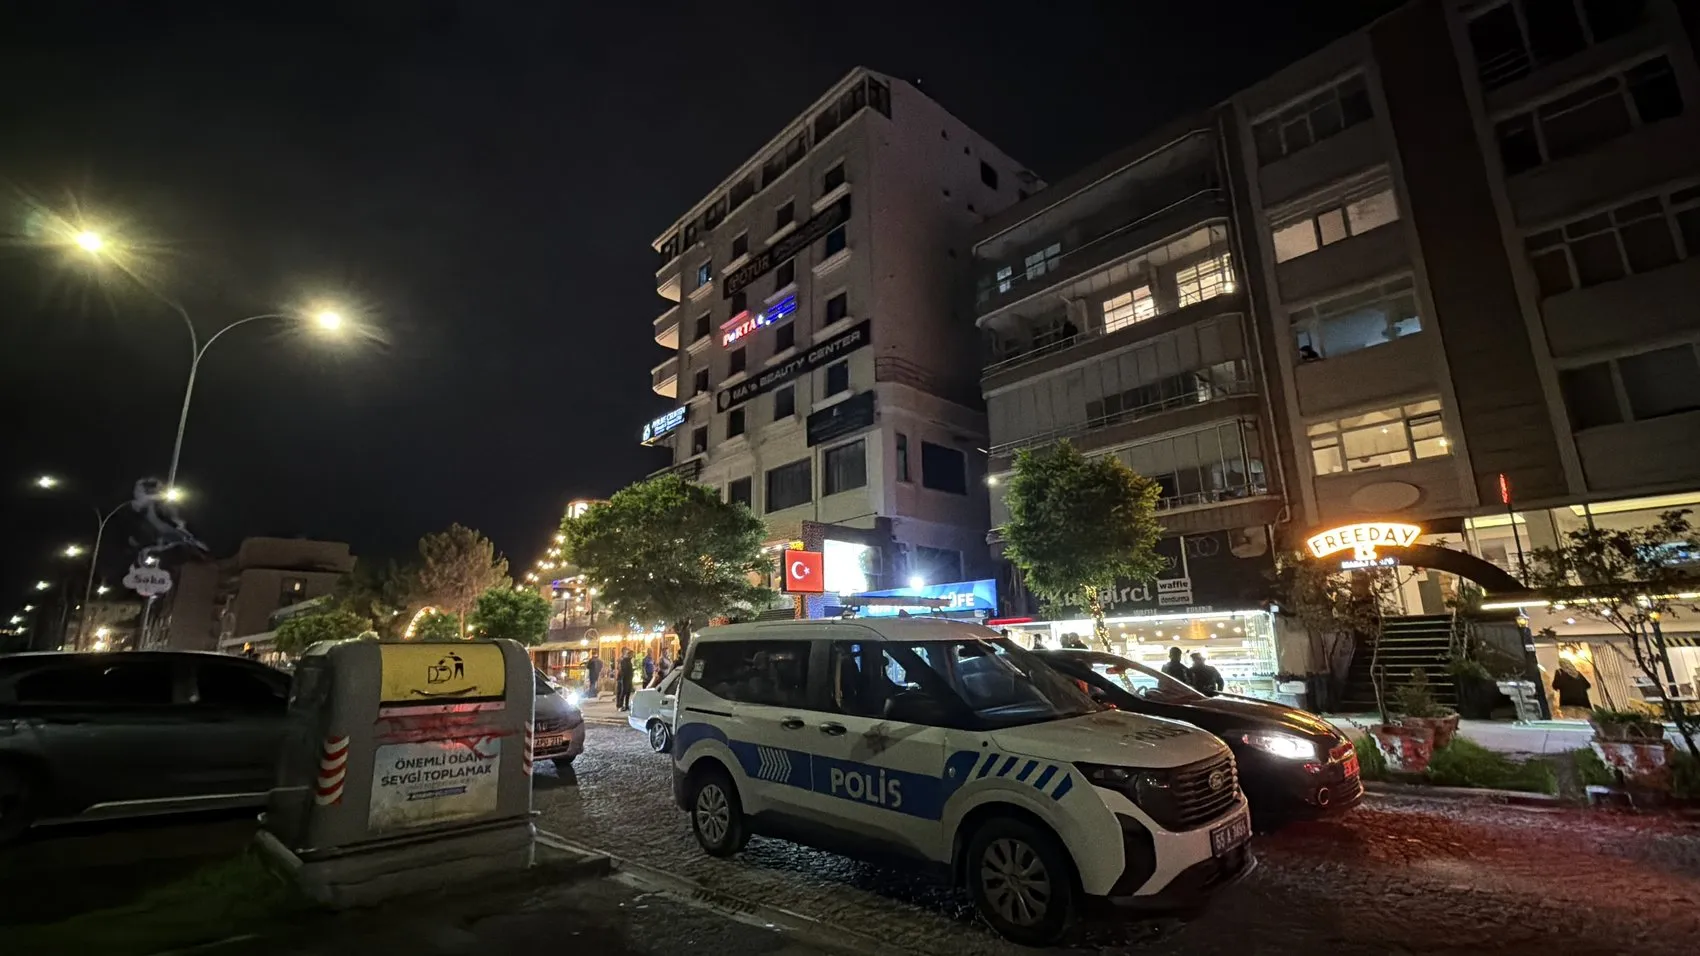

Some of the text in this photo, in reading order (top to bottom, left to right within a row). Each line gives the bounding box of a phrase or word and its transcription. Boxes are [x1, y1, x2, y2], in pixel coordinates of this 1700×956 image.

[759, 360, 807, 386] BEAUTY
[808, 330, 861, 363] CENTER
[1313, 527, 1414, 554] FREEDAY
[381, 769, 422, 786] SEVGİ
[423, 764, 492, 781] TOPLAMAK
[395, 754, 446, 770] ÖNEMLİ
[831, 767, 902, 808] POLİS
